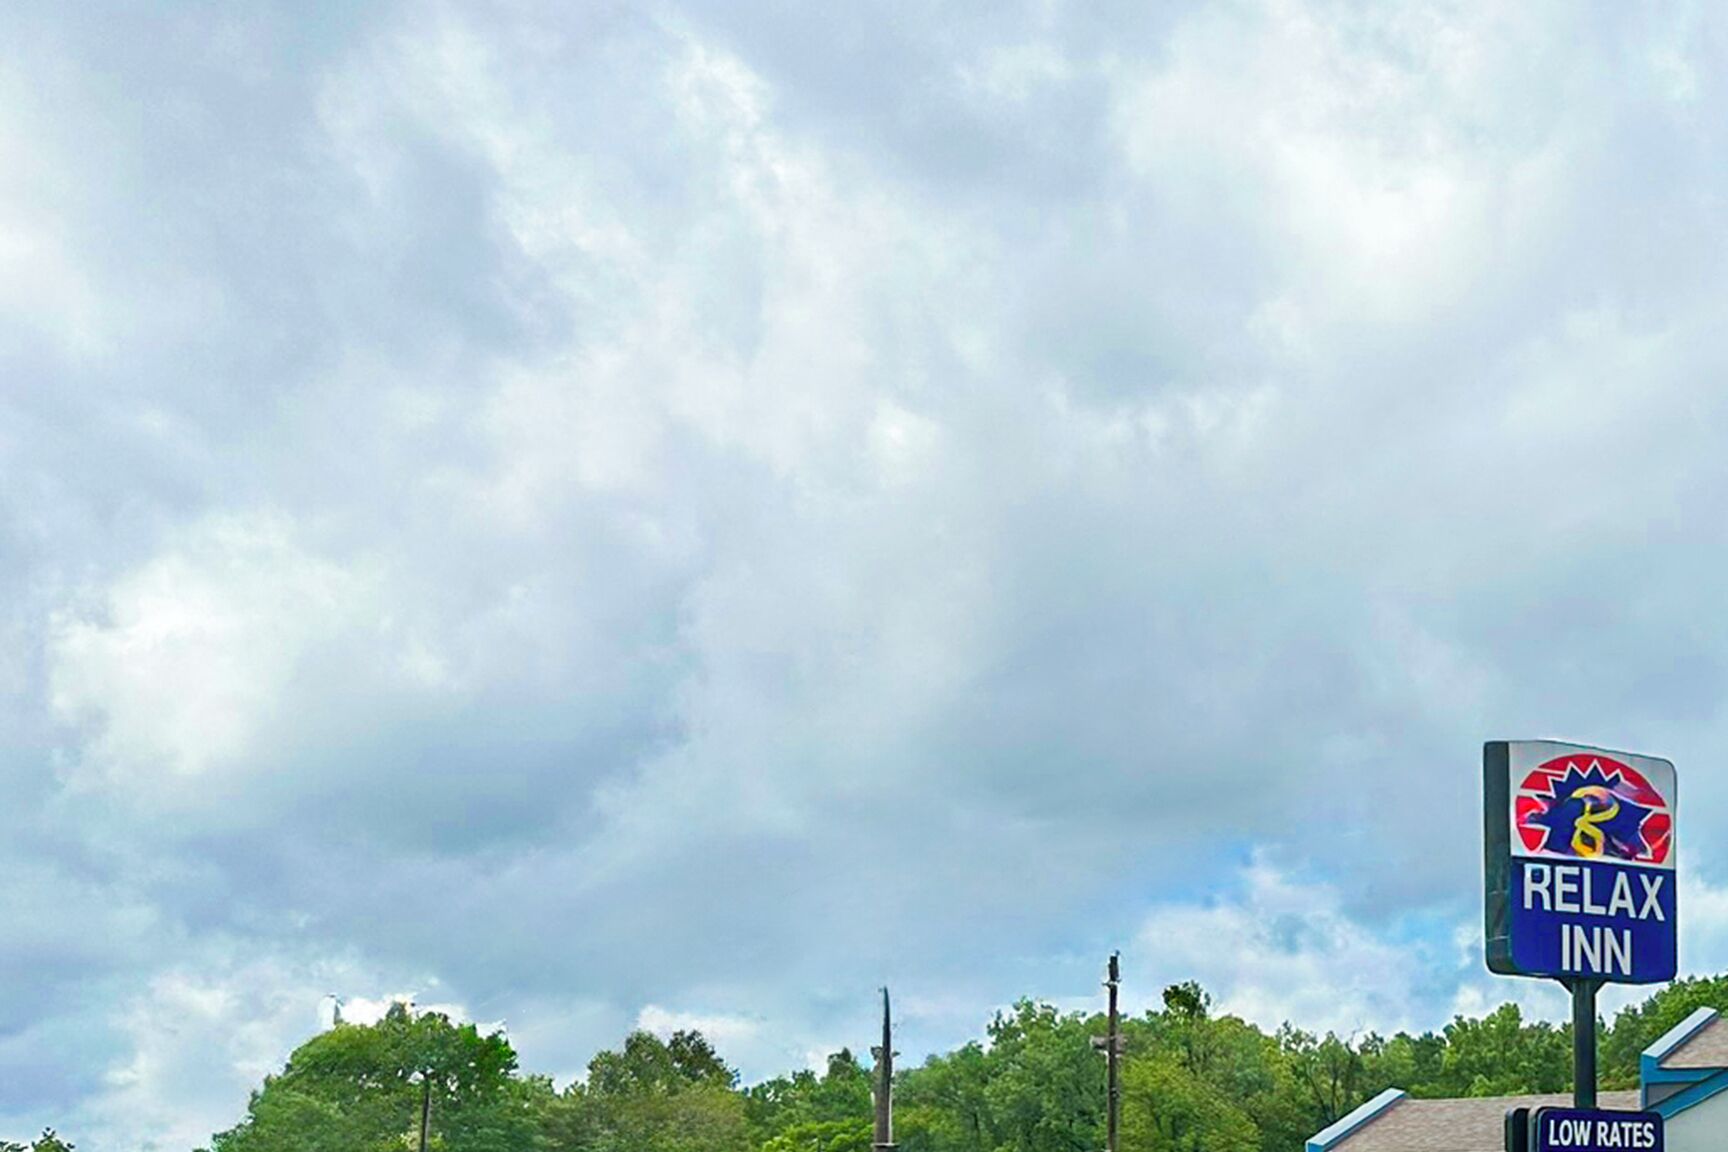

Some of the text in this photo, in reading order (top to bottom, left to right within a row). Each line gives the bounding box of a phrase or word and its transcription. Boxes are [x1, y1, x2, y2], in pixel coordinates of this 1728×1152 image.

[1523, 863, 1666, 922] RELAX
[1561, 924, 1632, 975] INN
[1548, 1119, 1656, 1148] LOW RATES
